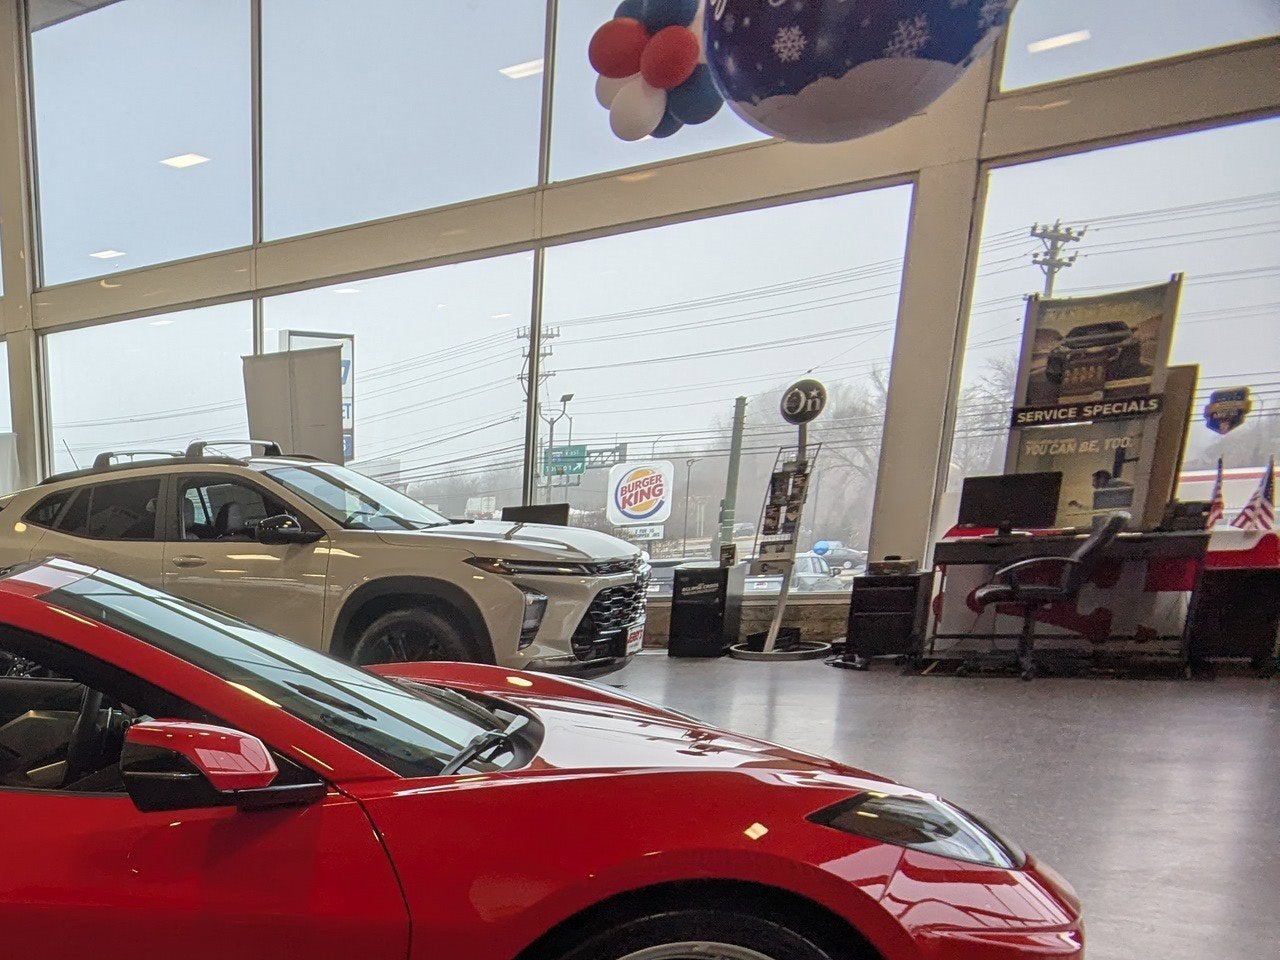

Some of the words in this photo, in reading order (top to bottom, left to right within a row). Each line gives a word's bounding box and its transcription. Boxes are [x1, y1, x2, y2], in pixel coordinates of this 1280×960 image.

[1017, 407, 1077, 423] SERVICE
[1083, 399, 1159, 417] SPECIALS
[620, 474, 662, 497] BURGER
[622, 484, 664, 510] KING
